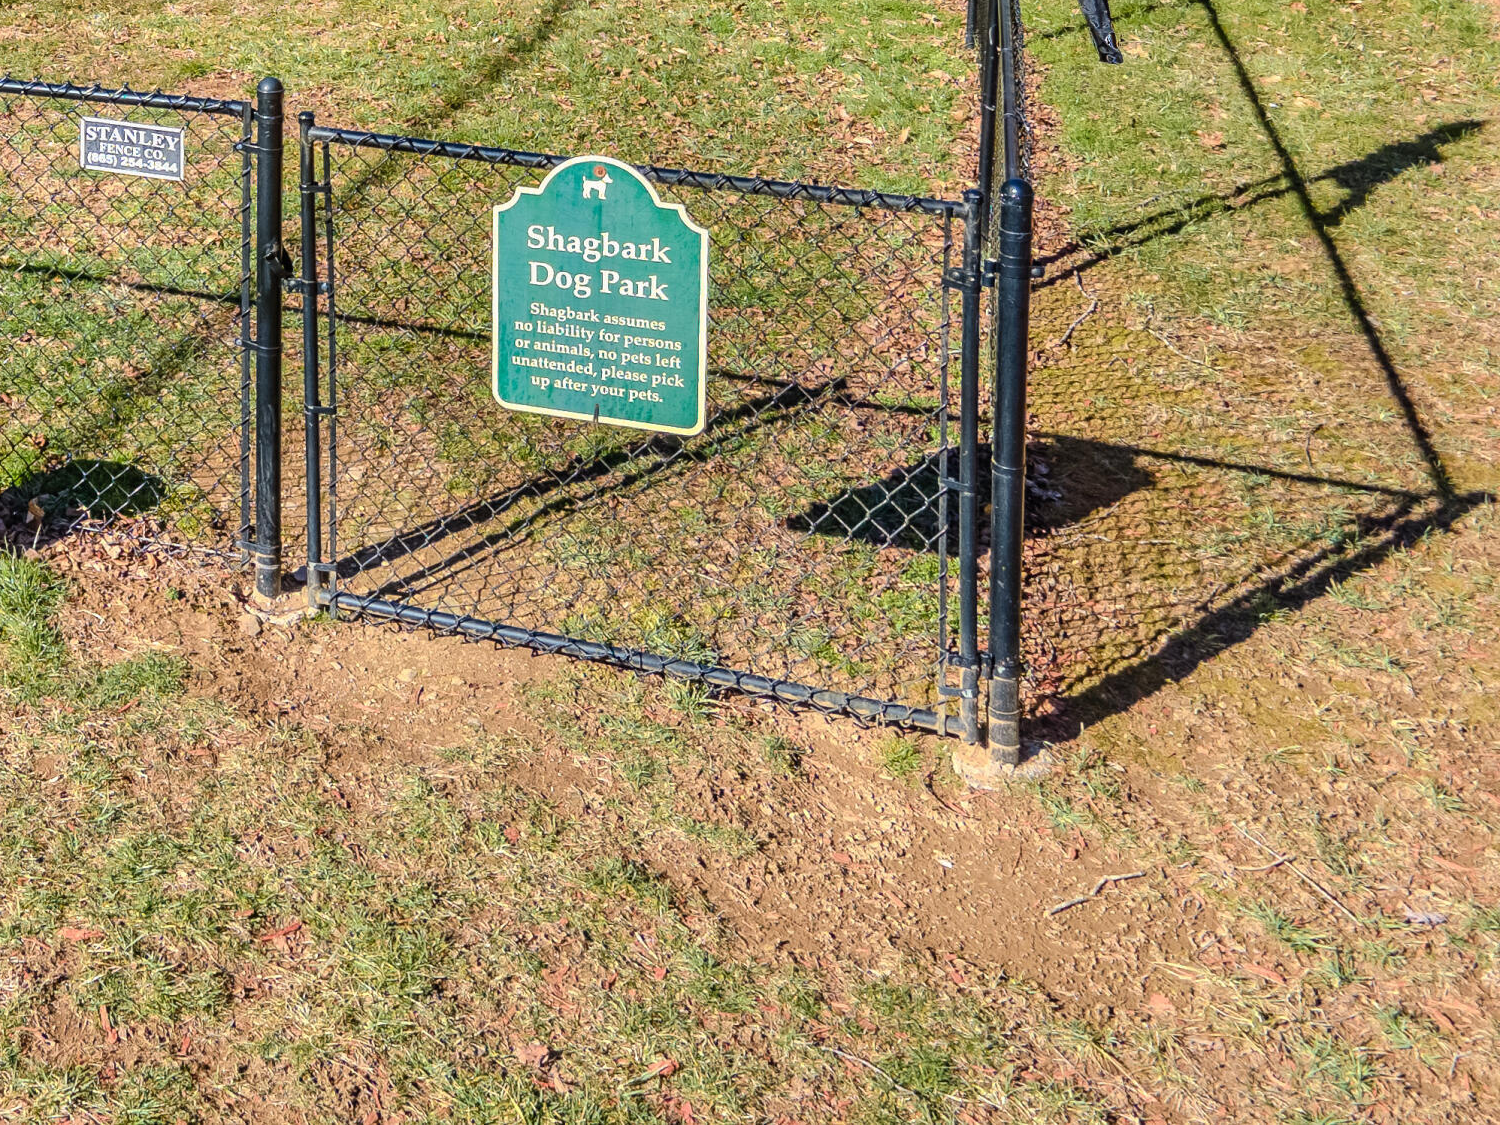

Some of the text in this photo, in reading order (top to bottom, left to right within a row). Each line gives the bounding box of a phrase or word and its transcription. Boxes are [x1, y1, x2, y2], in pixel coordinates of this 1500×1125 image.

[86, 126, 180, 151] STANLEY
[100, 142, 167, 161] FENCE CO.
[87, 151, 118, 167] (865)
[527, 225, 672, 264] Shagbark
[528, 261, 669, 301] Dog Park
[530, 302, 666, 331] Shagbark assumes
[514, 321, 682, 351] no liability for persons
[515, 338, 682, 369] or animals, no pets left
[512, 355, 685, 388] unattended, please pick
[531, 376, 664, 403] up after your pets.
